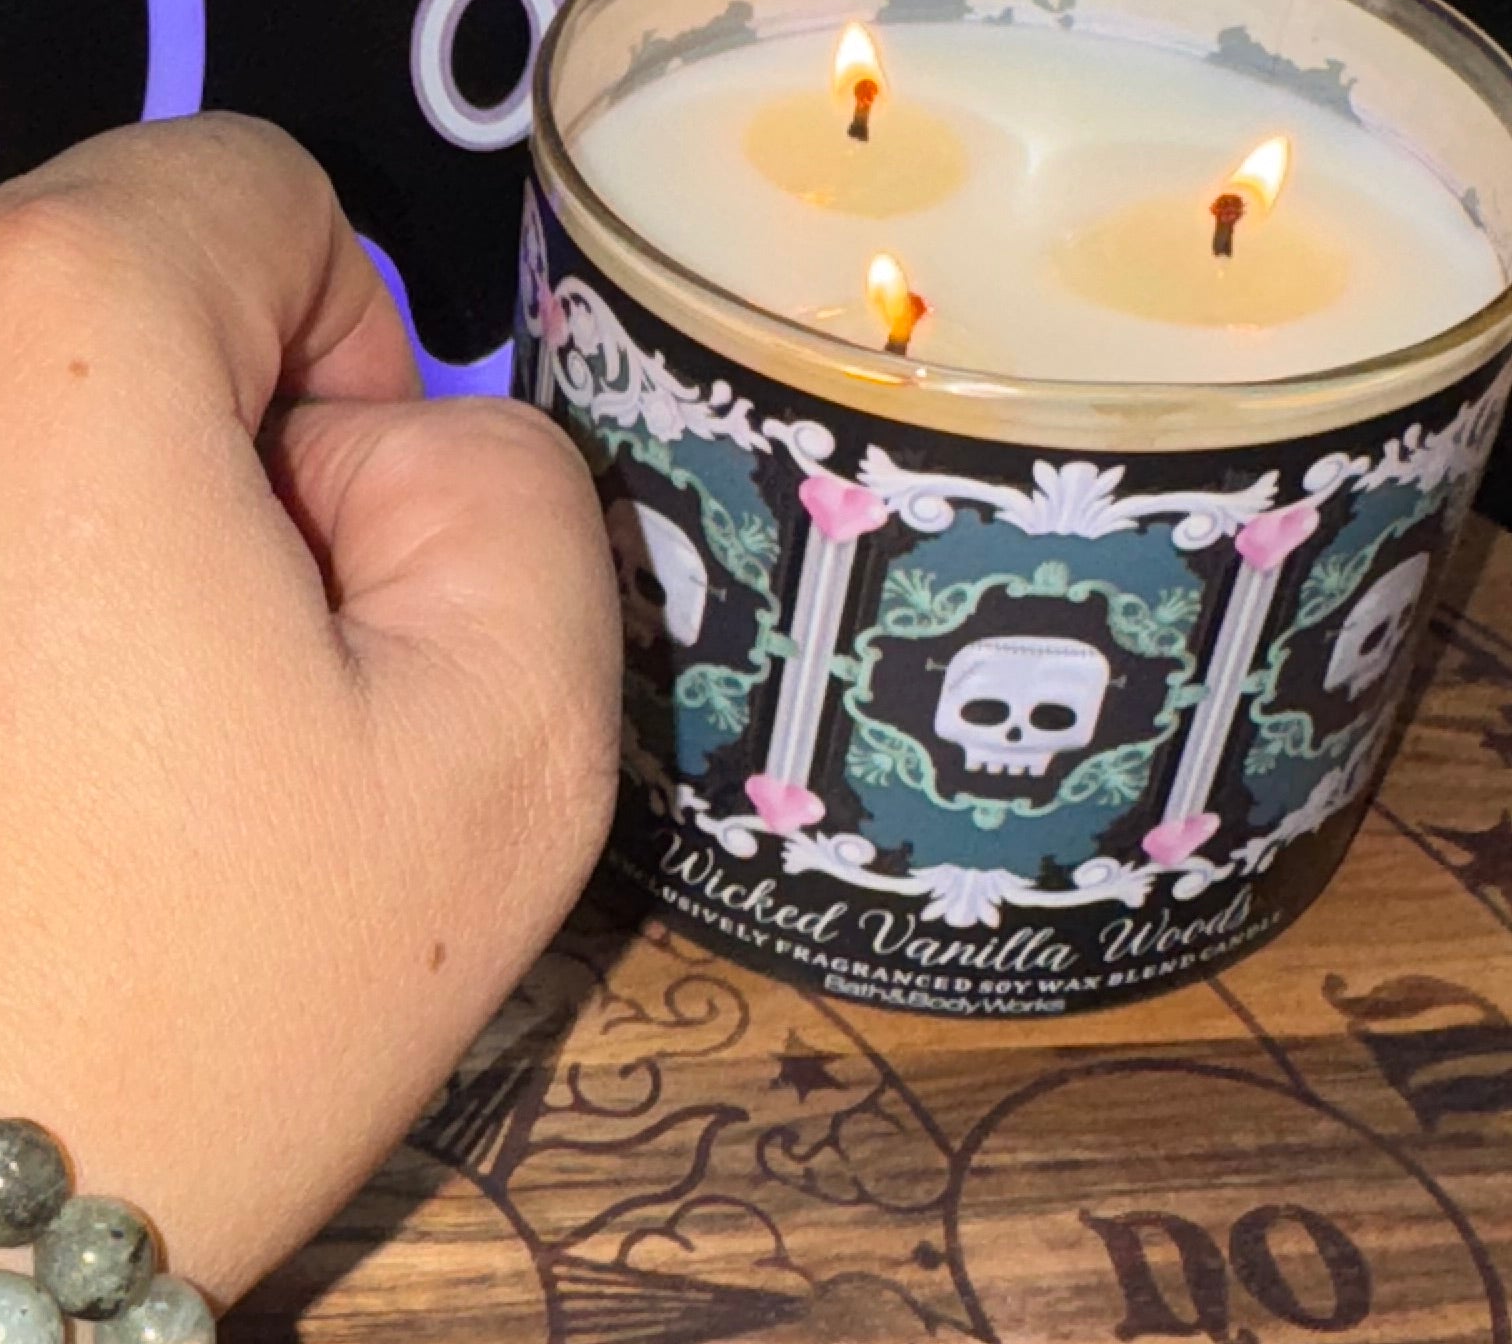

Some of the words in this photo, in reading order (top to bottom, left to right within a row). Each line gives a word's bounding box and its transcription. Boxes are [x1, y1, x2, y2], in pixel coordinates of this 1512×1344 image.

[656, 829, 848, 942] Wicked
[858, 908, 1080, 974] Vanilla
[1098, 882, 1256, 964] Woods
[775, 938, 973, 994] FRAGRANCED
[978, 978, 1032, 996] SOY
[1037, 975, 1103, 995] WAX
[1106, 954, 1197, 988] BLEND
